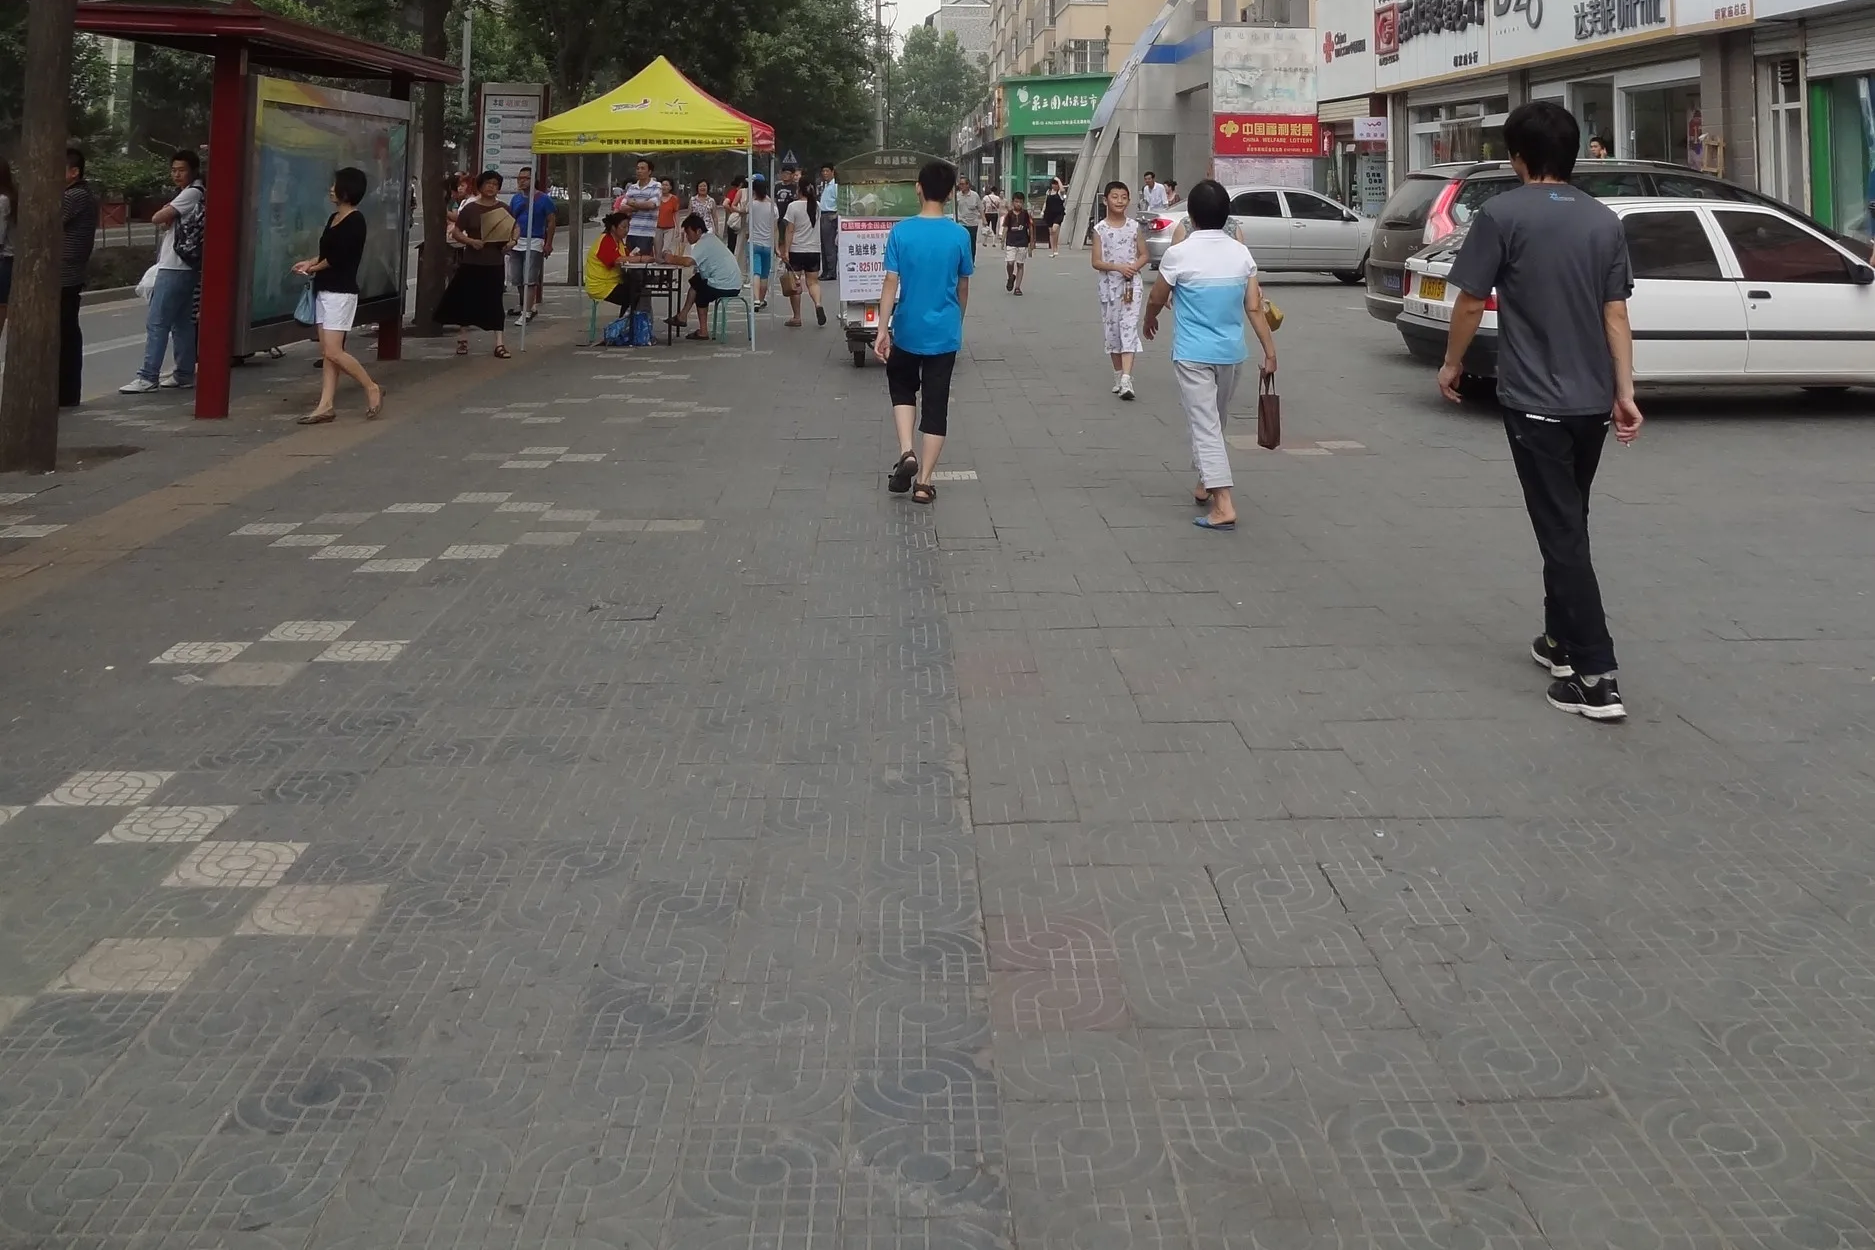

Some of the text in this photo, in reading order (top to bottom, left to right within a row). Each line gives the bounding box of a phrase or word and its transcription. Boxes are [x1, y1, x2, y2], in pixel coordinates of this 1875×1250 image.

[1242, 123, 1313, 136] 中国福利彩票
[841, 222, 897, 230] 电脑服务全国连锁
[848, 243, 877, 256] 电脑维修
